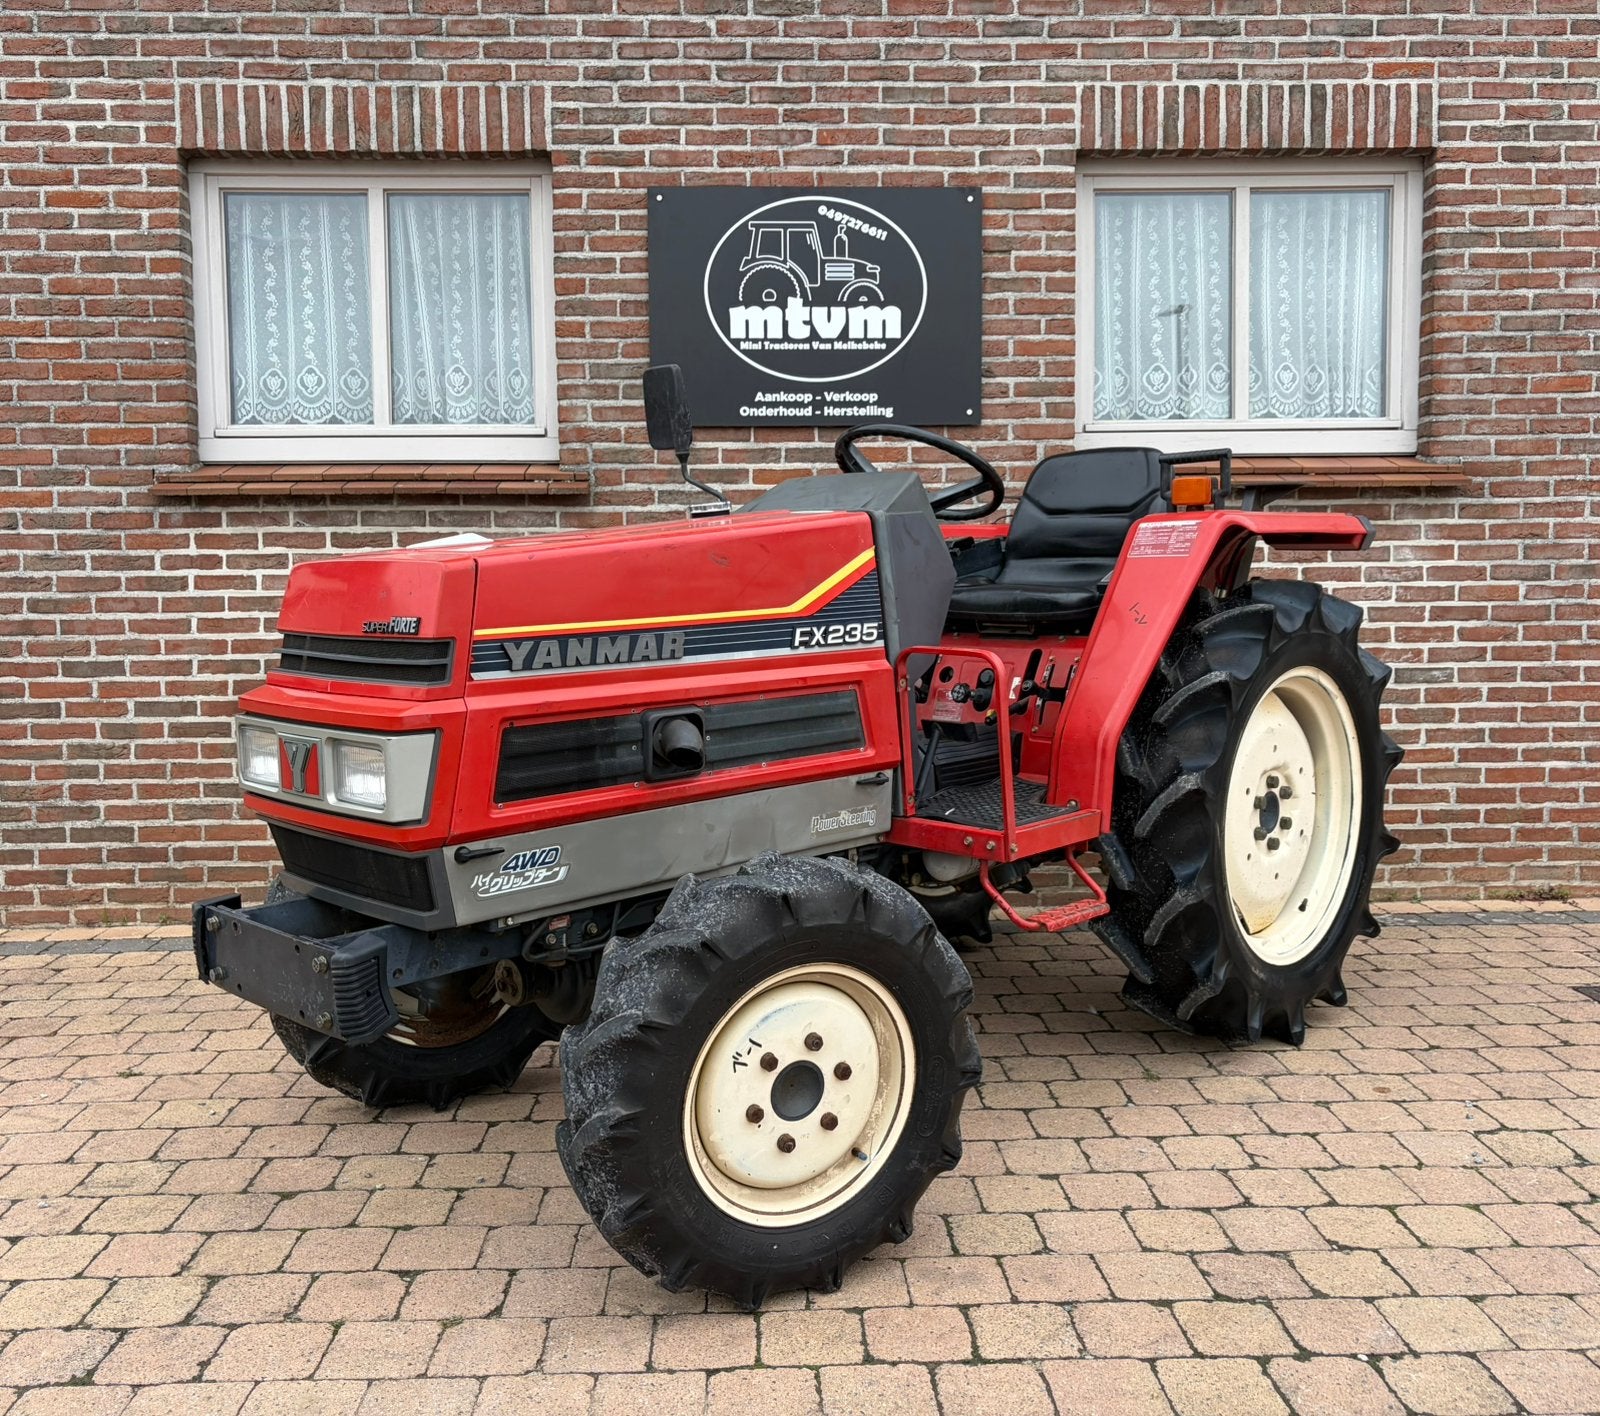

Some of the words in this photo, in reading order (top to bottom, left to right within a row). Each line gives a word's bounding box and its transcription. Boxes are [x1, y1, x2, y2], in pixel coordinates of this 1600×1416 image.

[817, 204, 888, 242] 0497276611
[728, 297, 902, 340] mtvm
[740, 341, 762, 350] Mini
[763, 341, 811, 350] Tractoren
[811, 341, 832, 350] Van
[739, 405, 813, 417] Onderhoud
[823, 405, 894, 418] Herstelling
[754, 391, 813, 404] Aankoop
[823, 391, 879, 404] Verkoop
[793, 621, 880, 648] FX235
[502, 632, 686, 671] YANMAR
[499, 845, 562, 874] 4WD
